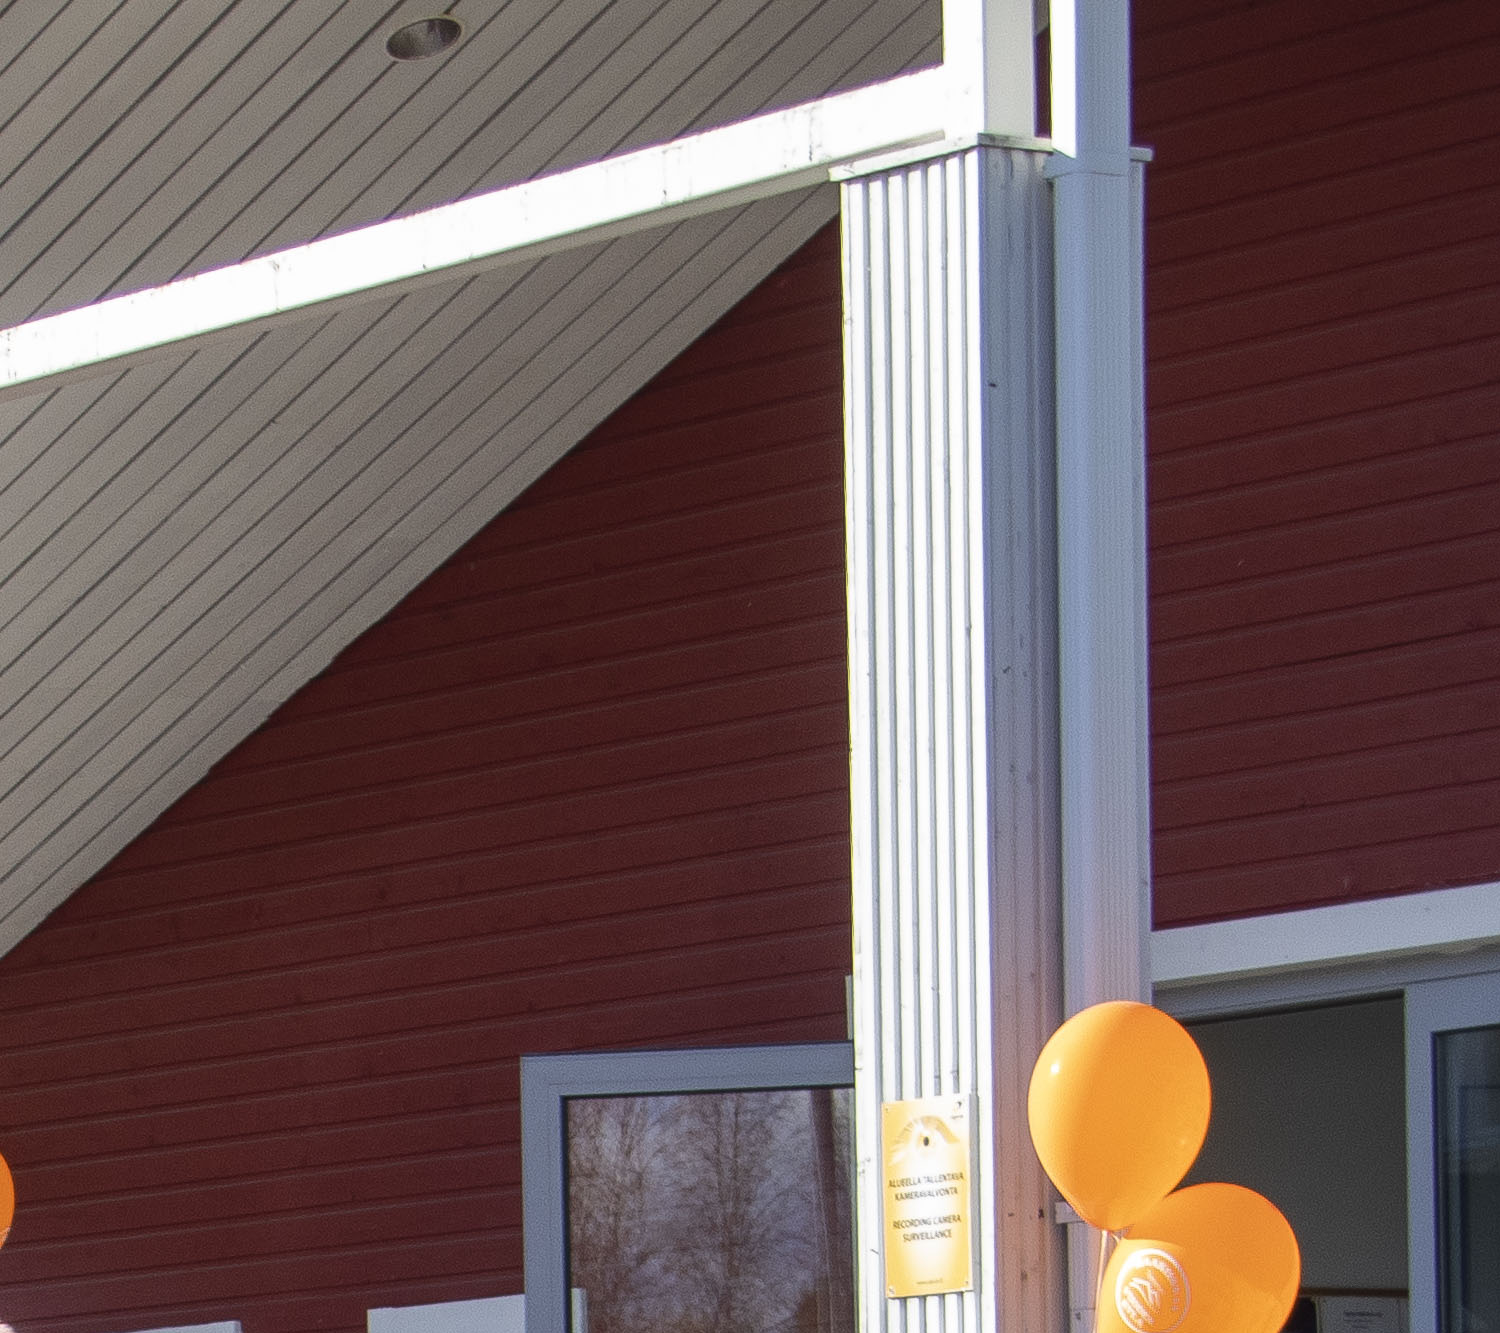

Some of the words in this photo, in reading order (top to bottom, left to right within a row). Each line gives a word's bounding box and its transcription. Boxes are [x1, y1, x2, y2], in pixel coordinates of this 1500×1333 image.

[888, 1177, 921, 1187] ALUEELLA
[923, 1172, 963, 1183] TALLENTAVA
[895, 1187, 957, 1200] KAMERAVALVONTA
[893, 1218, 931, 1229] RECORDING
[933, 1214, 961, 1224] CAMERA
[903, 1229, 951, 1241] SURVEILLANCE
